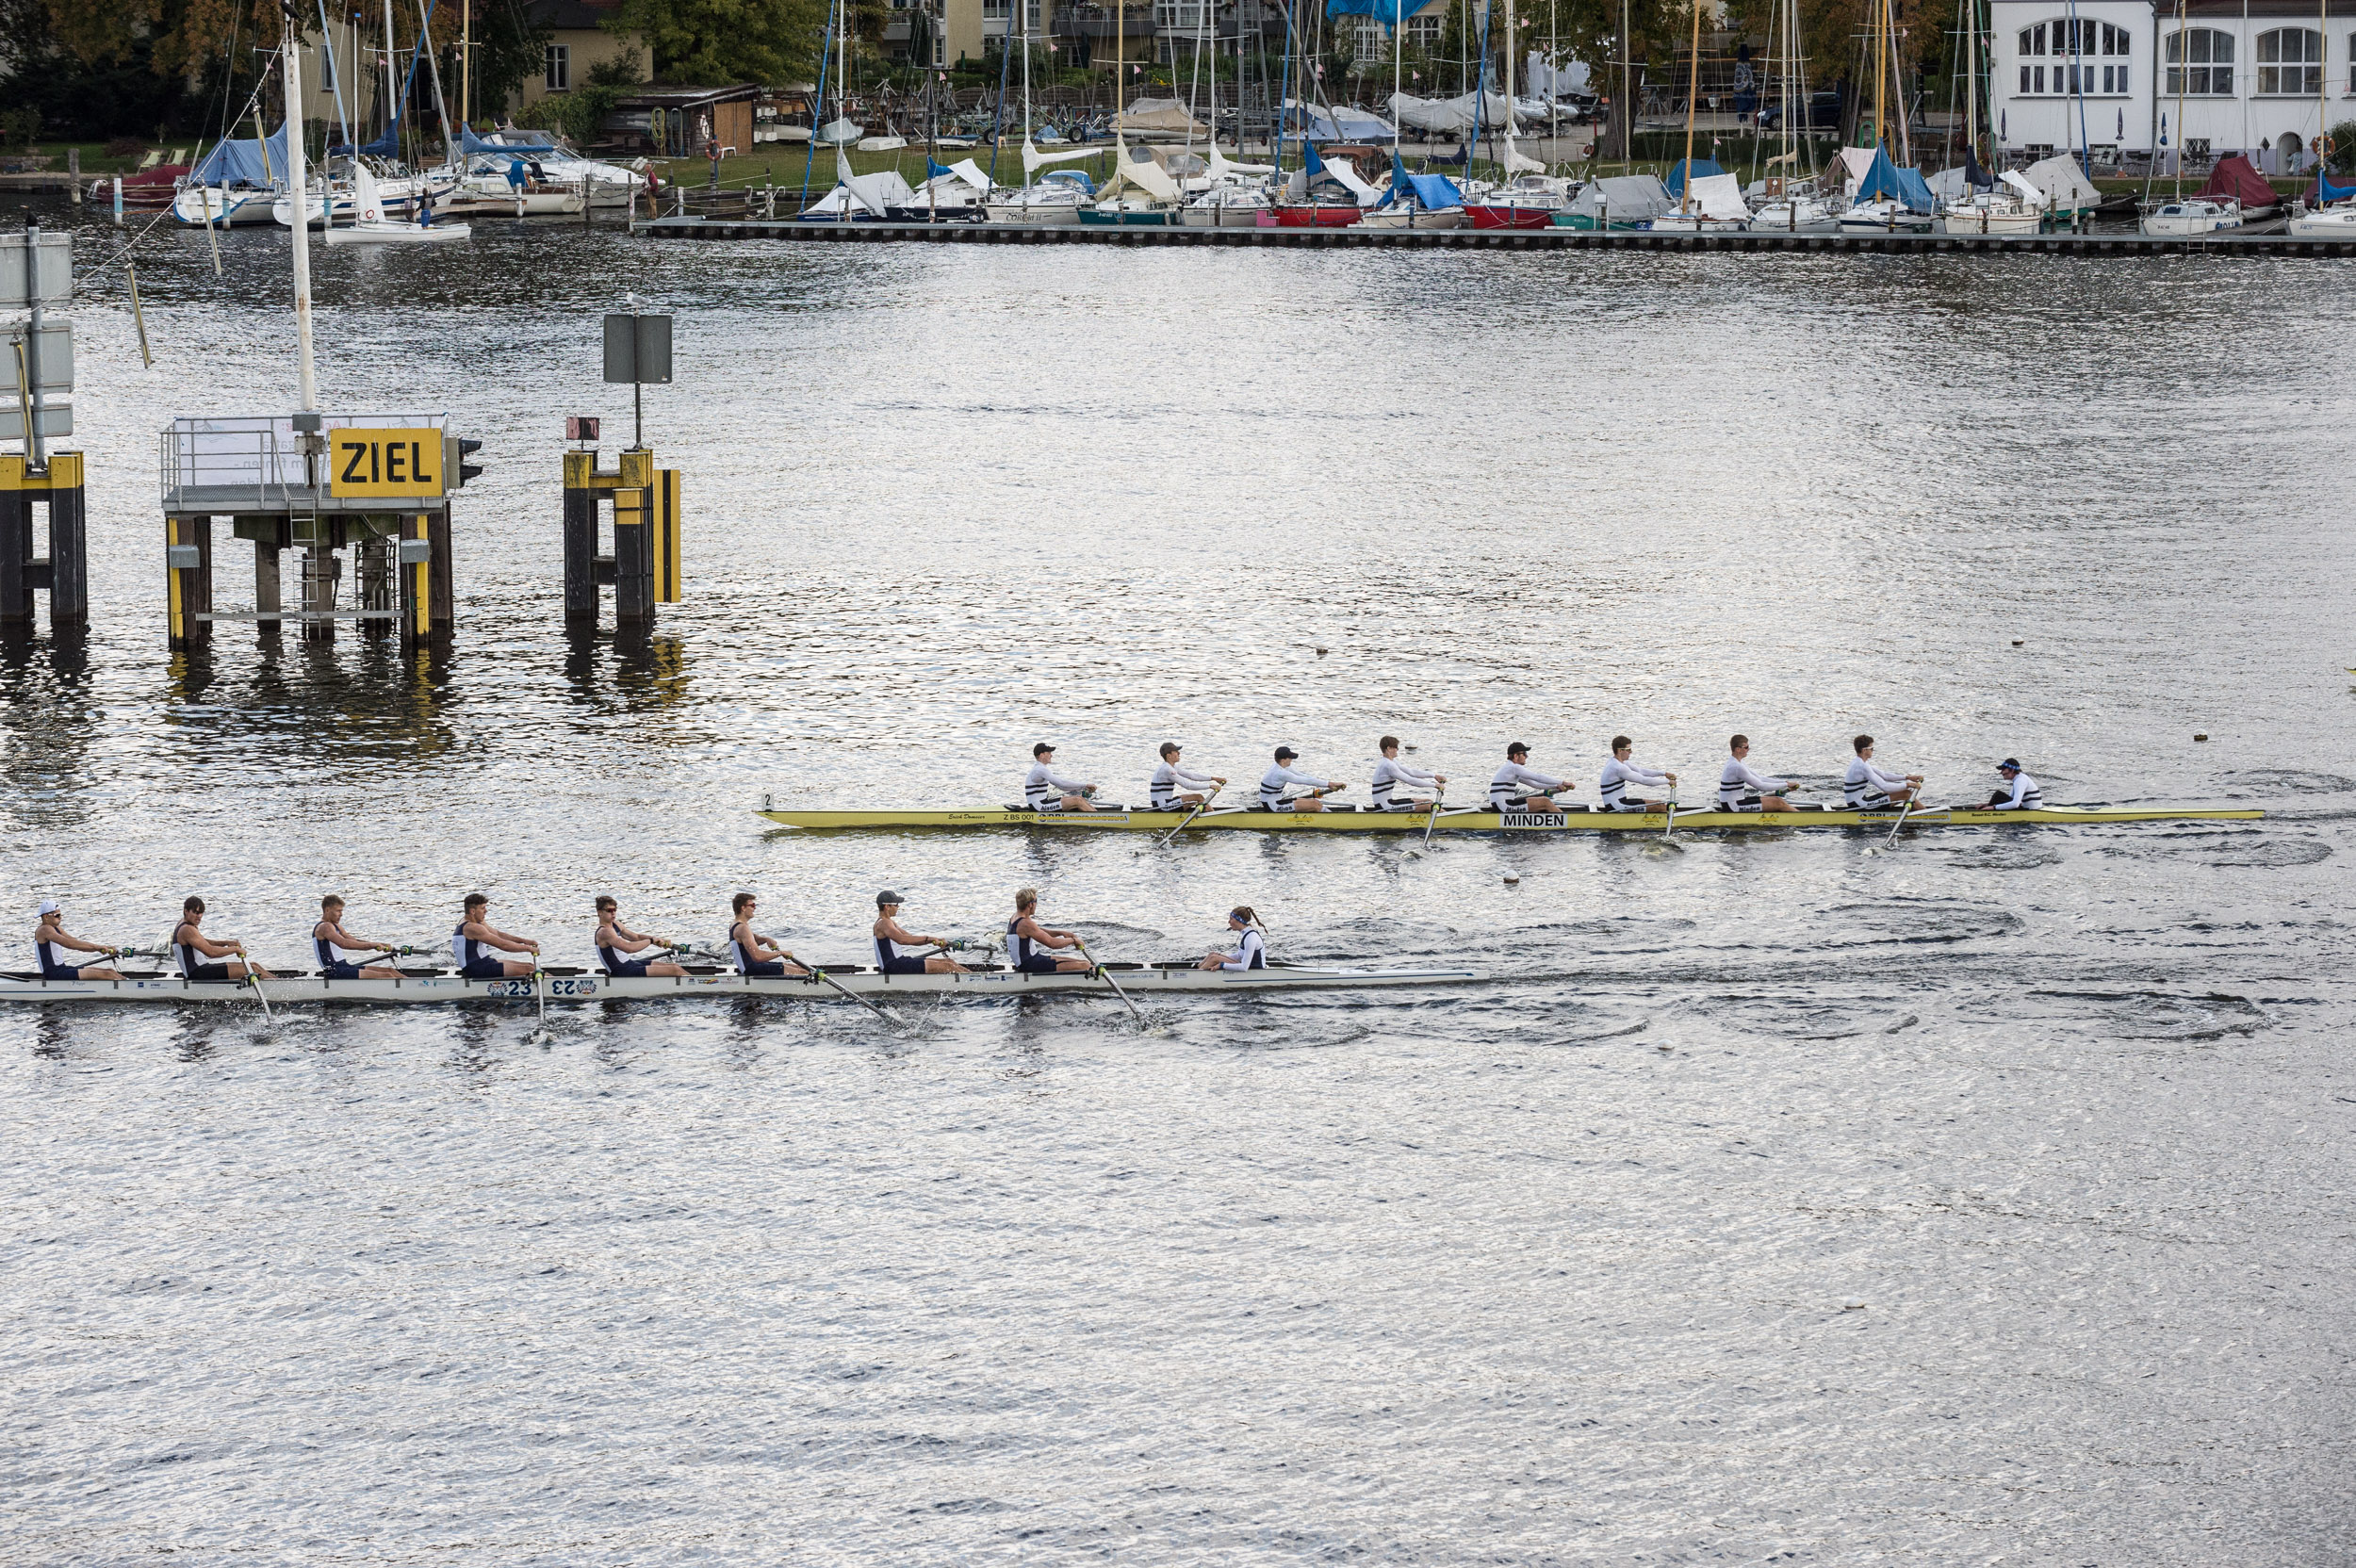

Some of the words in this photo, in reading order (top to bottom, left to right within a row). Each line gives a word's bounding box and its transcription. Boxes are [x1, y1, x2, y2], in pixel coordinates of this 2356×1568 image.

[341, 442, 432, 483] ZIEL
[764, 793, 771, 806] 2
[1503, 814, 1564, 826] MINDEN
[508, 981, 532, 996] 23
[551, 980, 576, 995] 23
